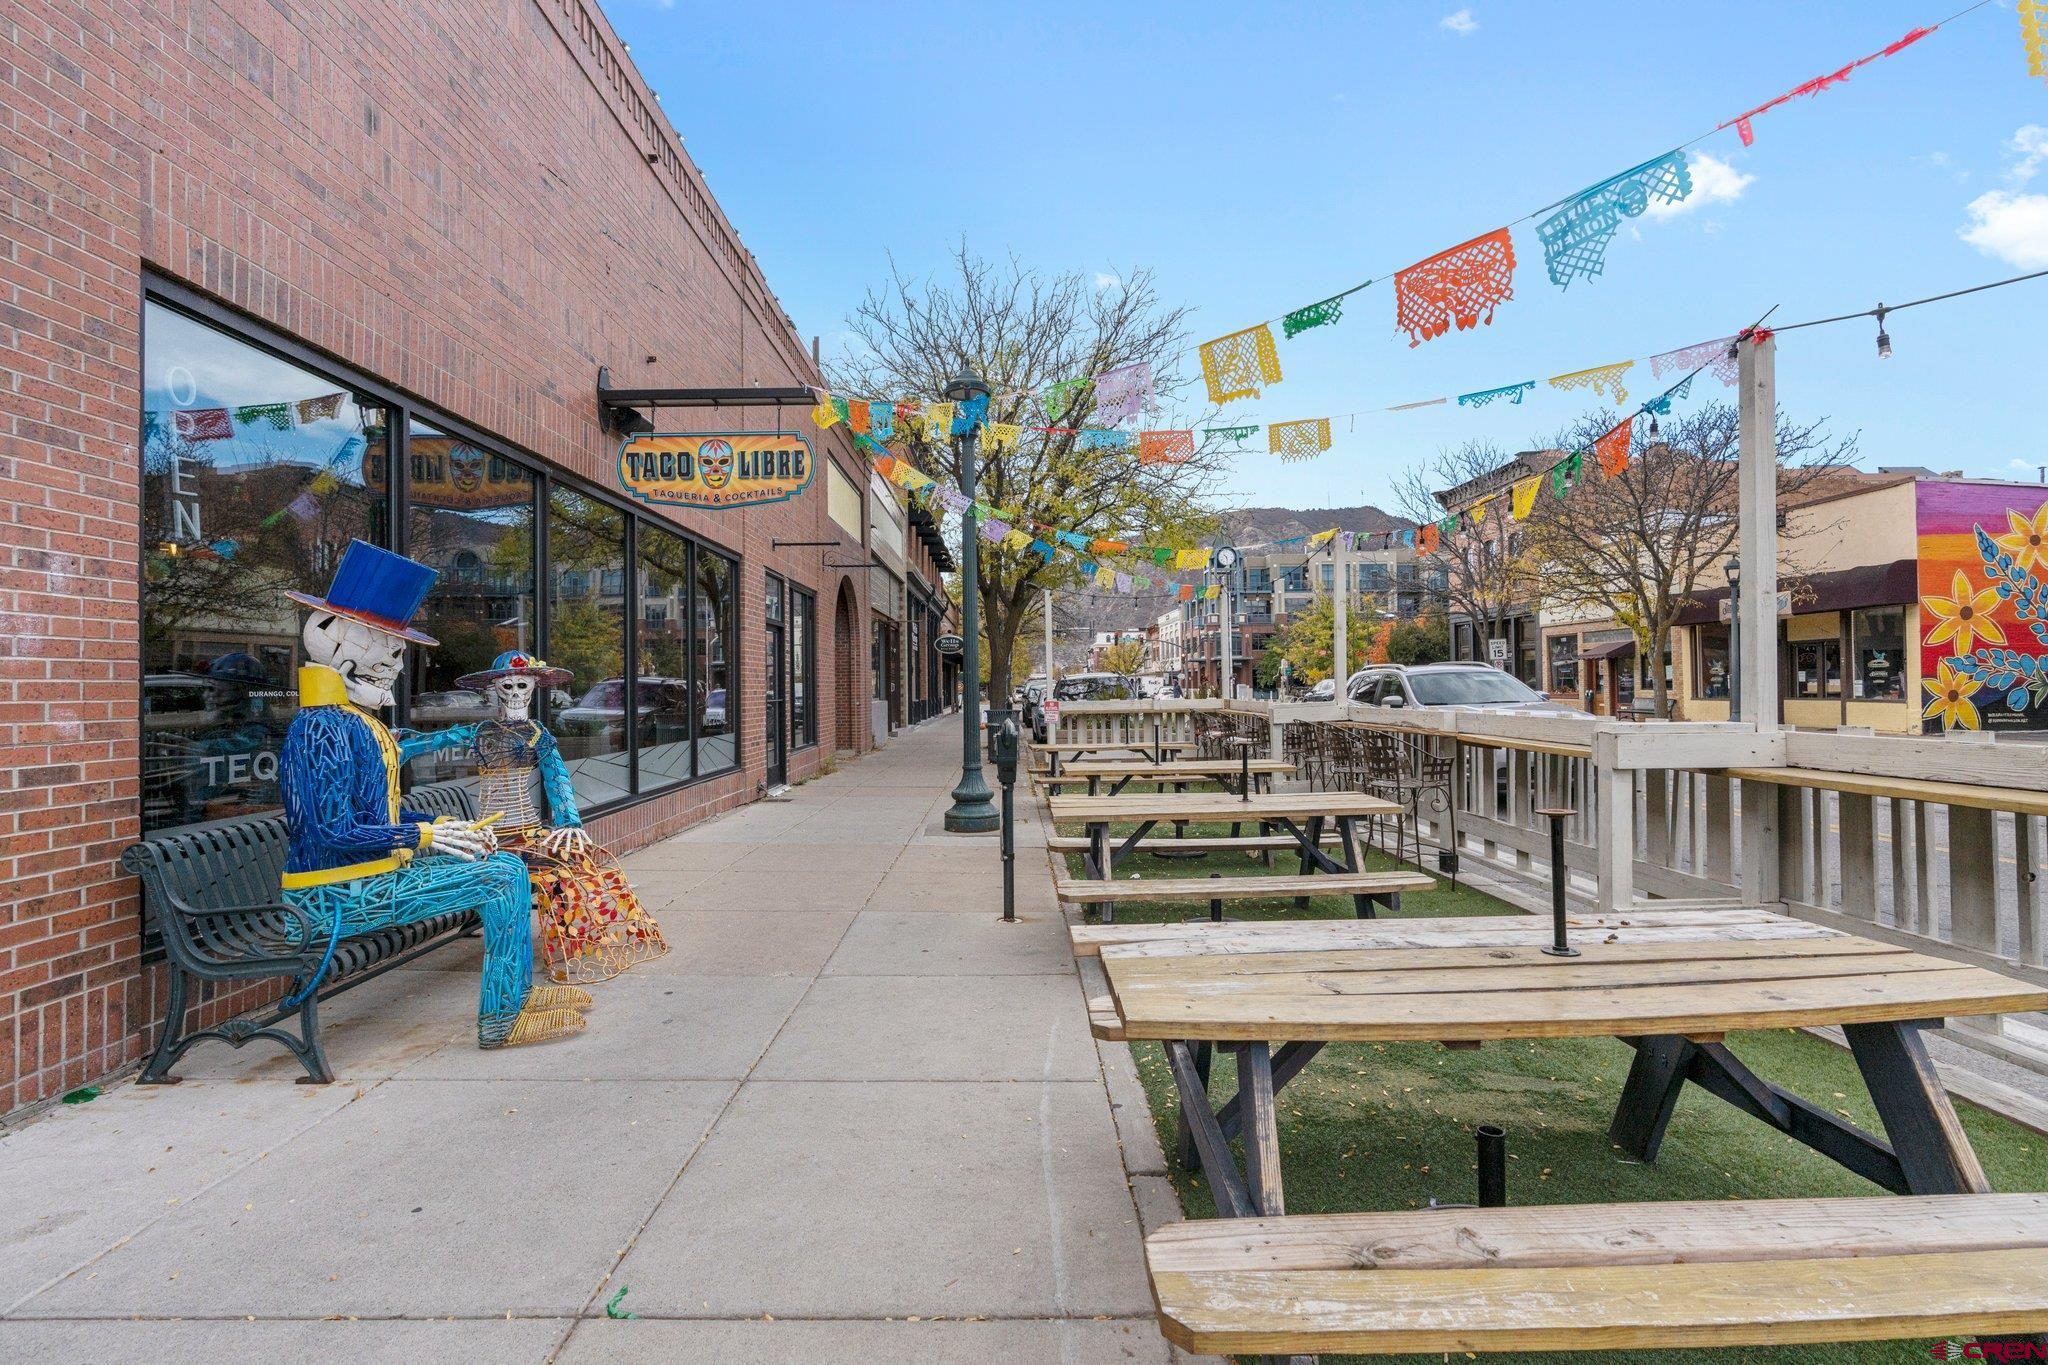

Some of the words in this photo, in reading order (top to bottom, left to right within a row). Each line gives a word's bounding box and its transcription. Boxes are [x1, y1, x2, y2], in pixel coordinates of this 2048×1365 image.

[169, 366, 200, 540] OPEN
[625, 451, 694, 482] TACO
[737, 450, 805, 480] LIBRE
[653, 489, 709, 502] TAQUERIA
[713, 493, 721, 503] &
[725, 486, 784, 501] COCKTAILS
[1493, 649, 1504, 657] 15
[248, 690, 285, 698] DURANGO,
[200, 751, 279, 786] TEQ
